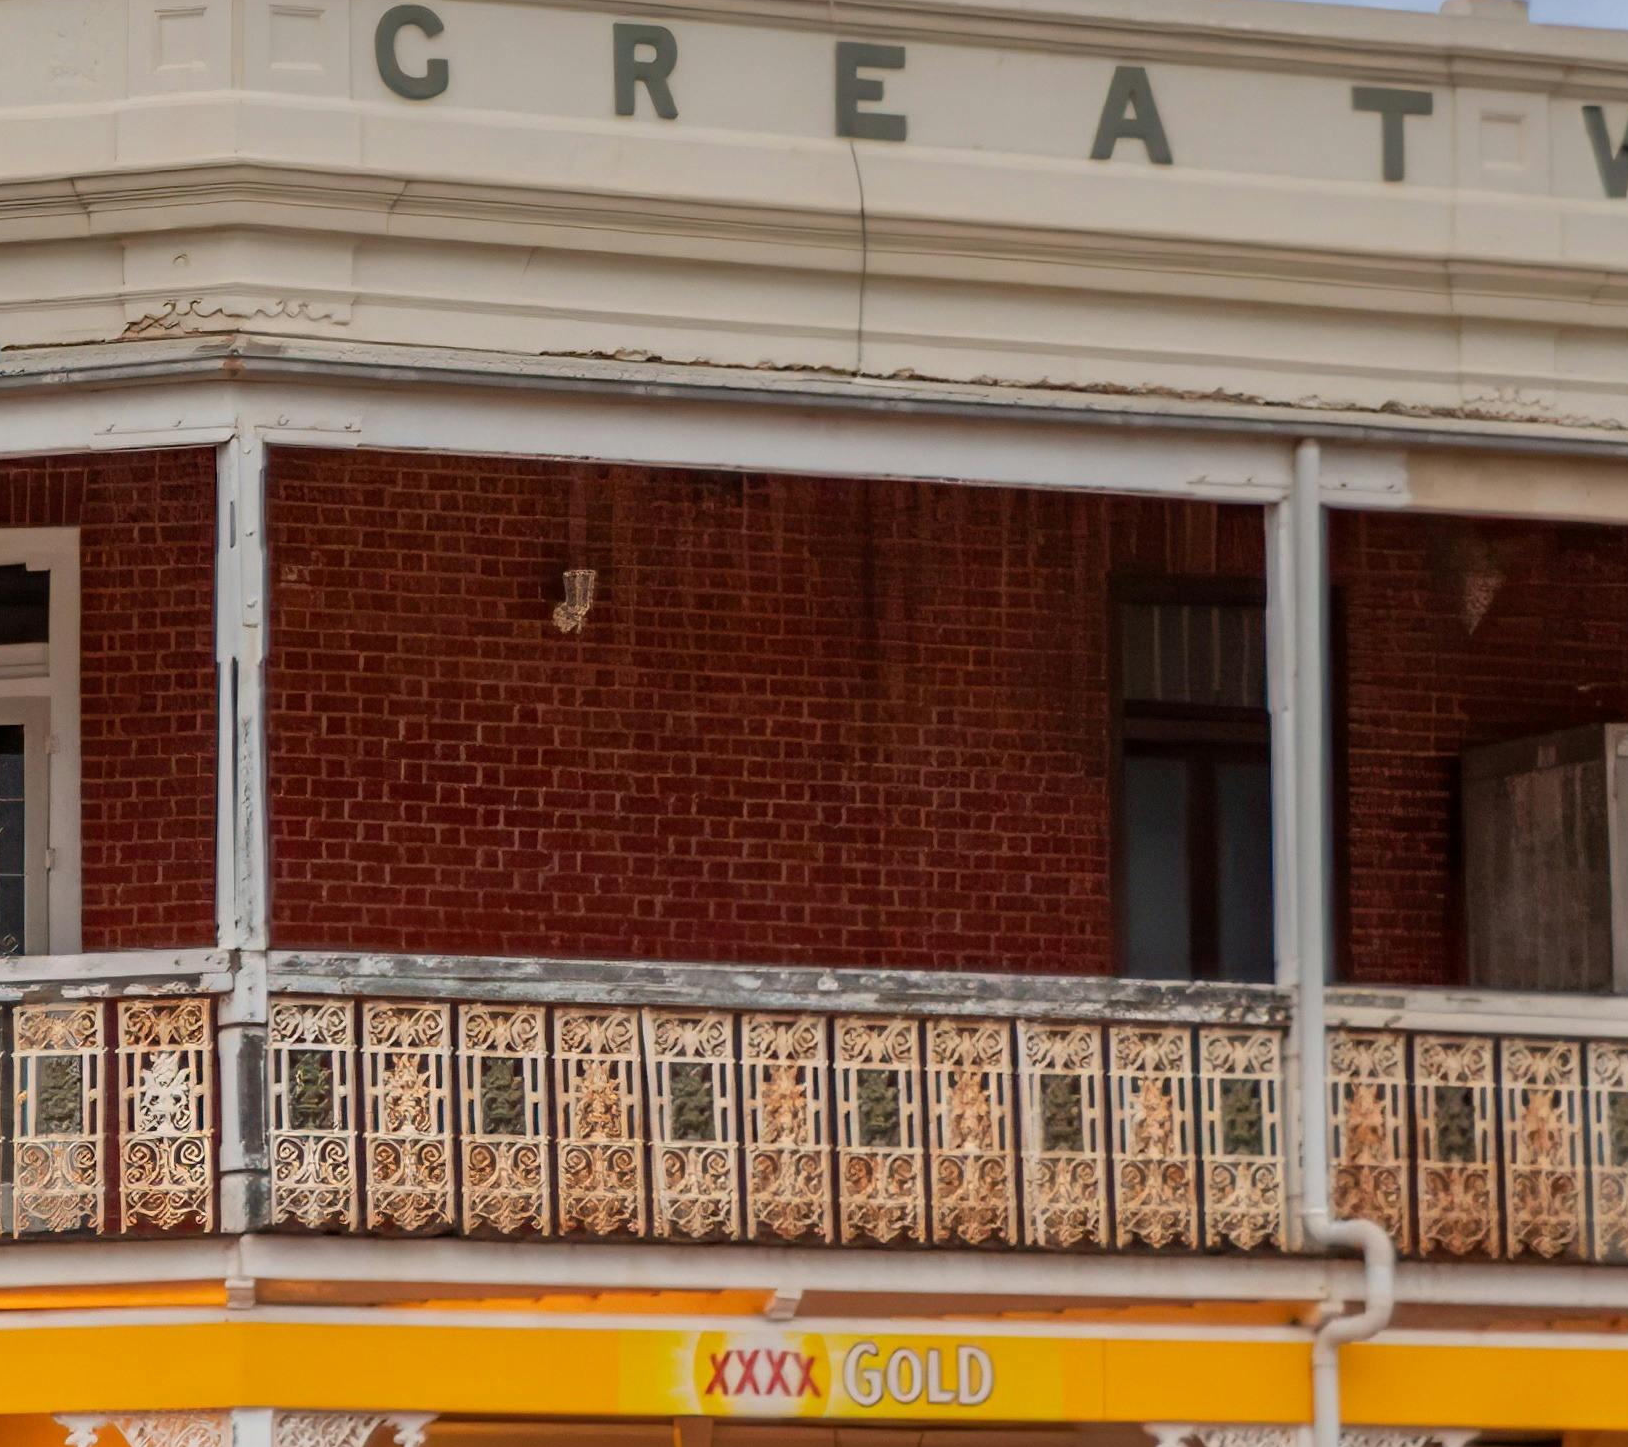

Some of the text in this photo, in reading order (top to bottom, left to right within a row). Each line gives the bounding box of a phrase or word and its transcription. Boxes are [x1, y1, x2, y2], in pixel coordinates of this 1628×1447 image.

[375, 4, 1432, 184] GREAT
[704, 1340, 995, 1408] XXXX GOLD
